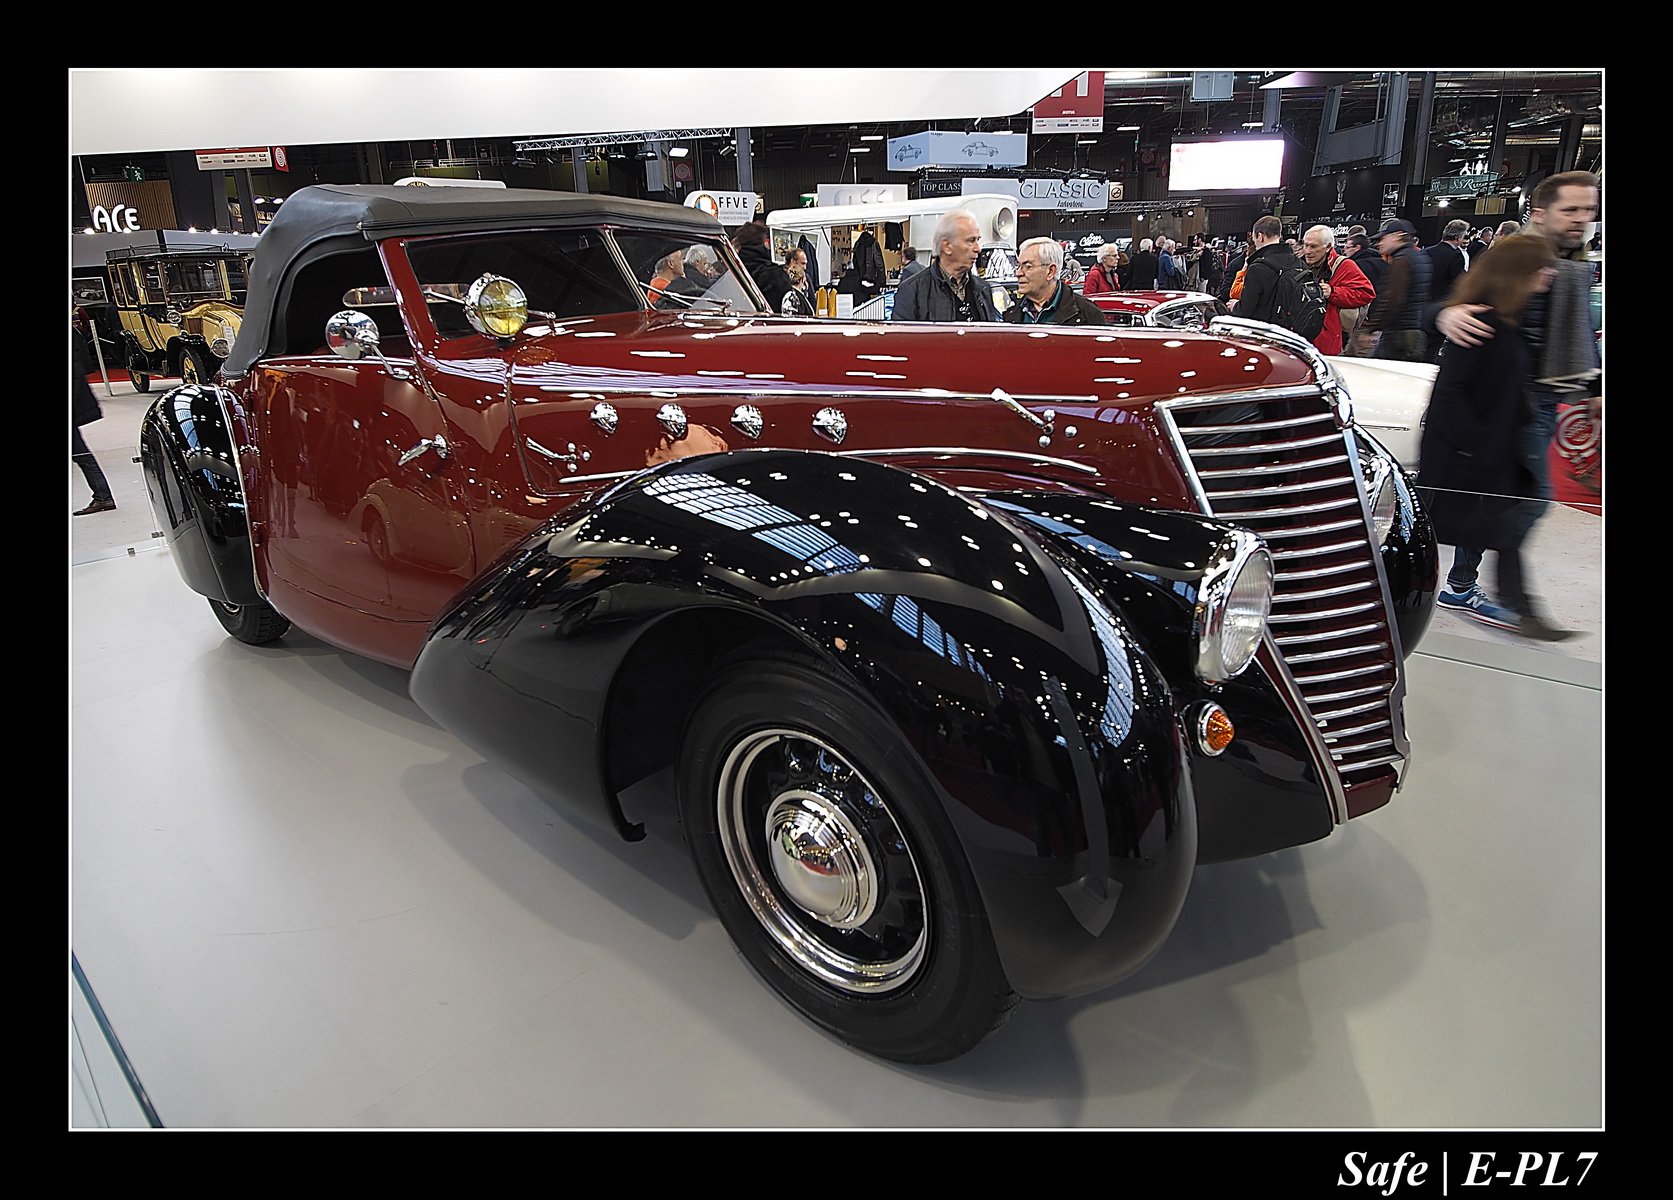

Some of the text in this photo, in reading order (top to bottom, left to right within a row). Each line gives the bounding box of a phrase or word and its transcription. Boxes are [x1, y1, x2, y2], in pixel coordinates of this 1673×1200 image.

[922, 182, 962, 191] TOP CLASS
[1020, 182, 1101, 199] CLASSIC
[718, 196, 748, 209] FFVE
[93, 203, 141, 233] ACE
